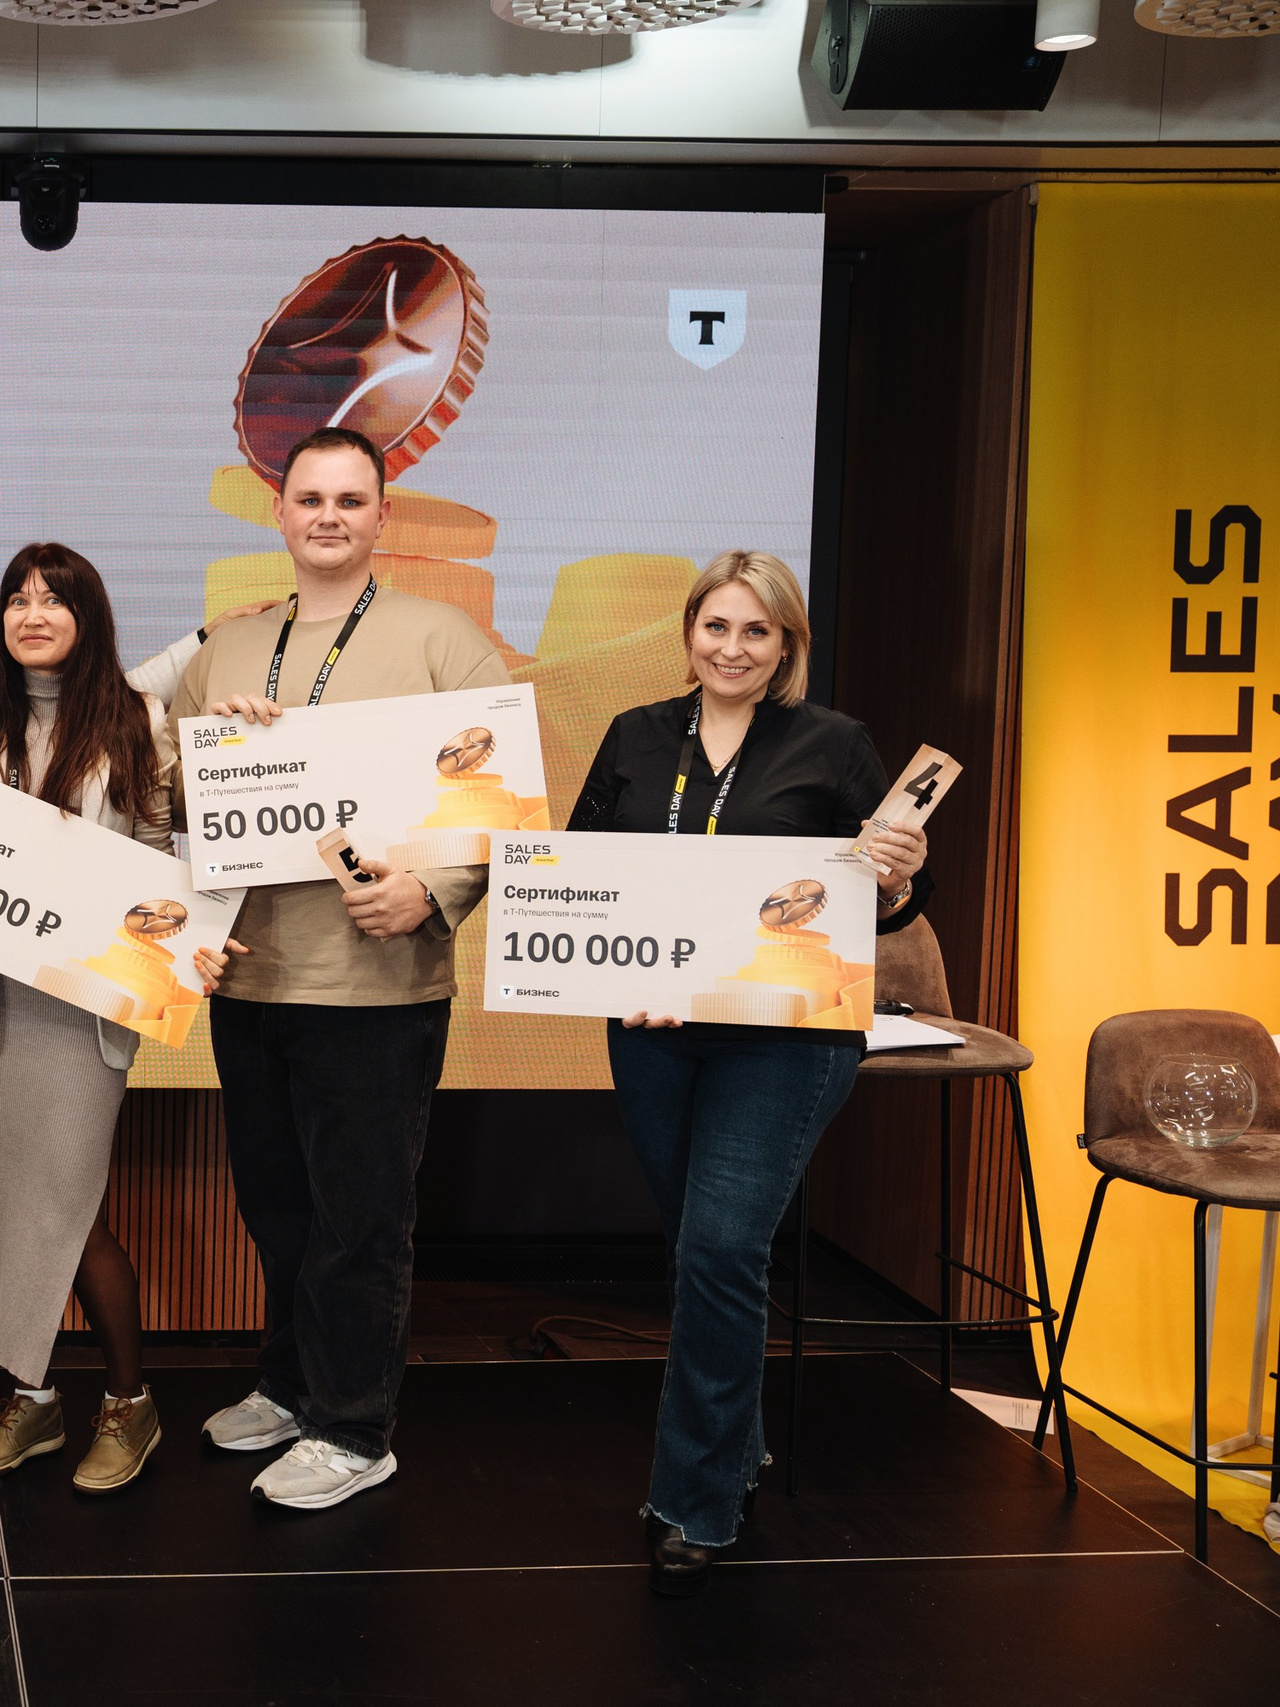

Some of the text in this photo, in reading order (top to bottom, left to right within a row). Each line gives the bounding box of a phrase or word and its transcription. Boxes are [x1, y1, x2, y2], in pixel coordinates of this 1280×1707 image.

[354, 590, 373, 615] SALES
[267, 653, 282, 701] SALES DAY
[309, 663, 332, 706] ALES DAY
[193, 726, 238, 739] SALES
[1164, 505, 1262, 946] SALES
[194, 738, 219, 749] DAY
[197, 761, 307, 782] Сертификат
[206, 785, 263, 797] Т-Путешествия
[275, 783, 299, 791] сумму
[710, 766, 736, 818] SALES DAY
[904, 761, 944, 811] 4
[670, 792, 682, 810] DAY
[203, 809, 247, 841] 50
[256, 802, 325, 836] 000
[668, 812, 678, 834] LES
[504, 855, 531, 864] DAY
[505, 844, 551, 855] SALES
[222, 861, 264, 872] БИЗНЕС
[504, 885, 620, 904] Сертификат
[510, 908, 569, 918] Т-Путешествия
[583, 912, 609, 920] сумму
[503, 931, 575, 964] 100
[585, 934, 659, 968] 000
[516, 988, 560, 998] БИЗНЕС
